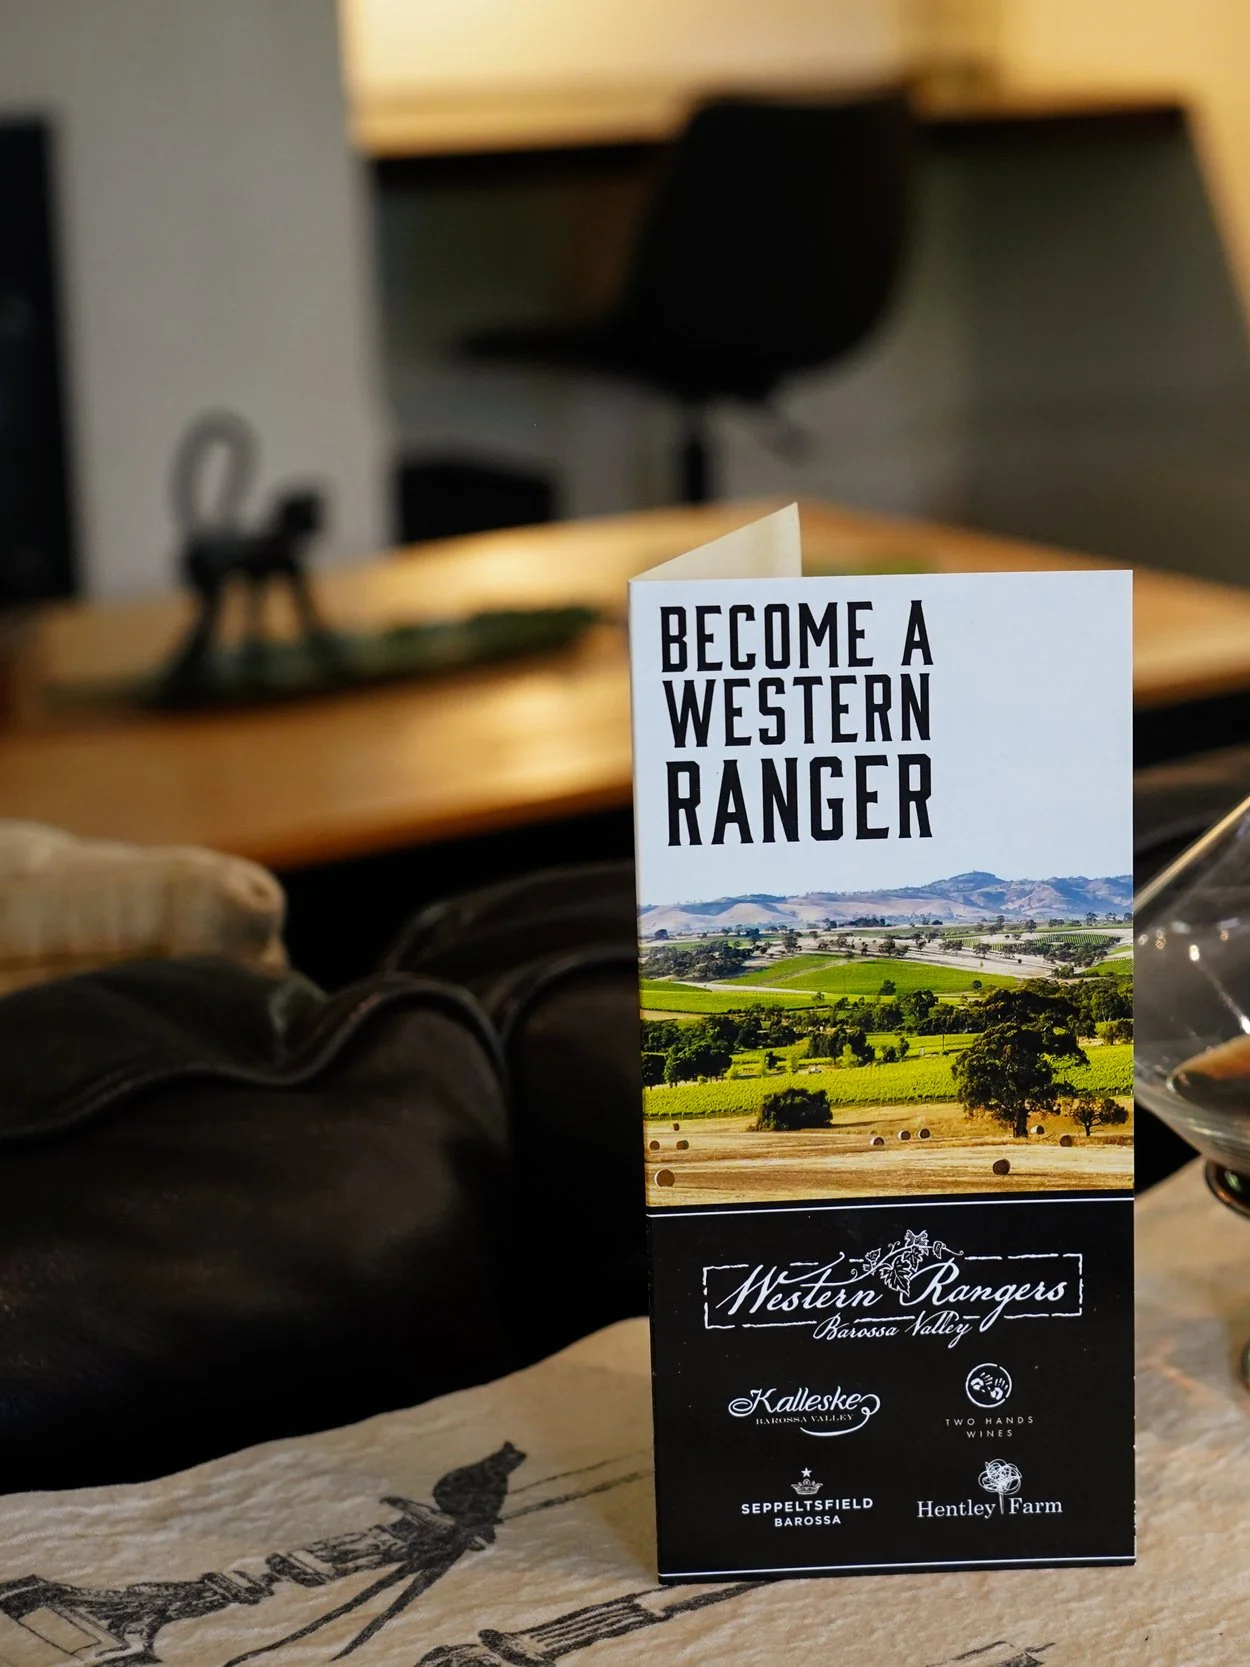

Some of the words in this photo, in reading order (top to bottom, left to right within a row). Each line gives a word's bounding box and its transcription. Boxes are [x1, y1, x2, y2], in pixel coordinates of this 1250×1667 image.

[660, 601, 874, 672] BECOME
[901, 600, 934, 666] A
[662, 673, 931, 748] WESTERN
[666, 753, 933, 846] RANGER
[716, 1255, 882, 1315] Western
[900, 1258, 1067, 1332] Rangers
[813, 1313, 899, 1340] Barossa
[905, 1310, 972, 1348] Valley
[728, 1386, 881, 1418] Kalleske
[755, 1416, 808, 1426] BAROSSA
[810, 1413, 854, 1423] VALLEY
[945, 1417, 976, 1427] TWO
[985, 1415, 1035, 1426] HANDS
[966, 1429, 1013, 1439] WINES
[741, 1497, 873, 1515] SEPPELTSFIELD
[916, 1499, 996, 1519] Hentley
[1008, 1497, 1063, 1515] Farm
[774, 1515, 841, 1528] BAROSSA
